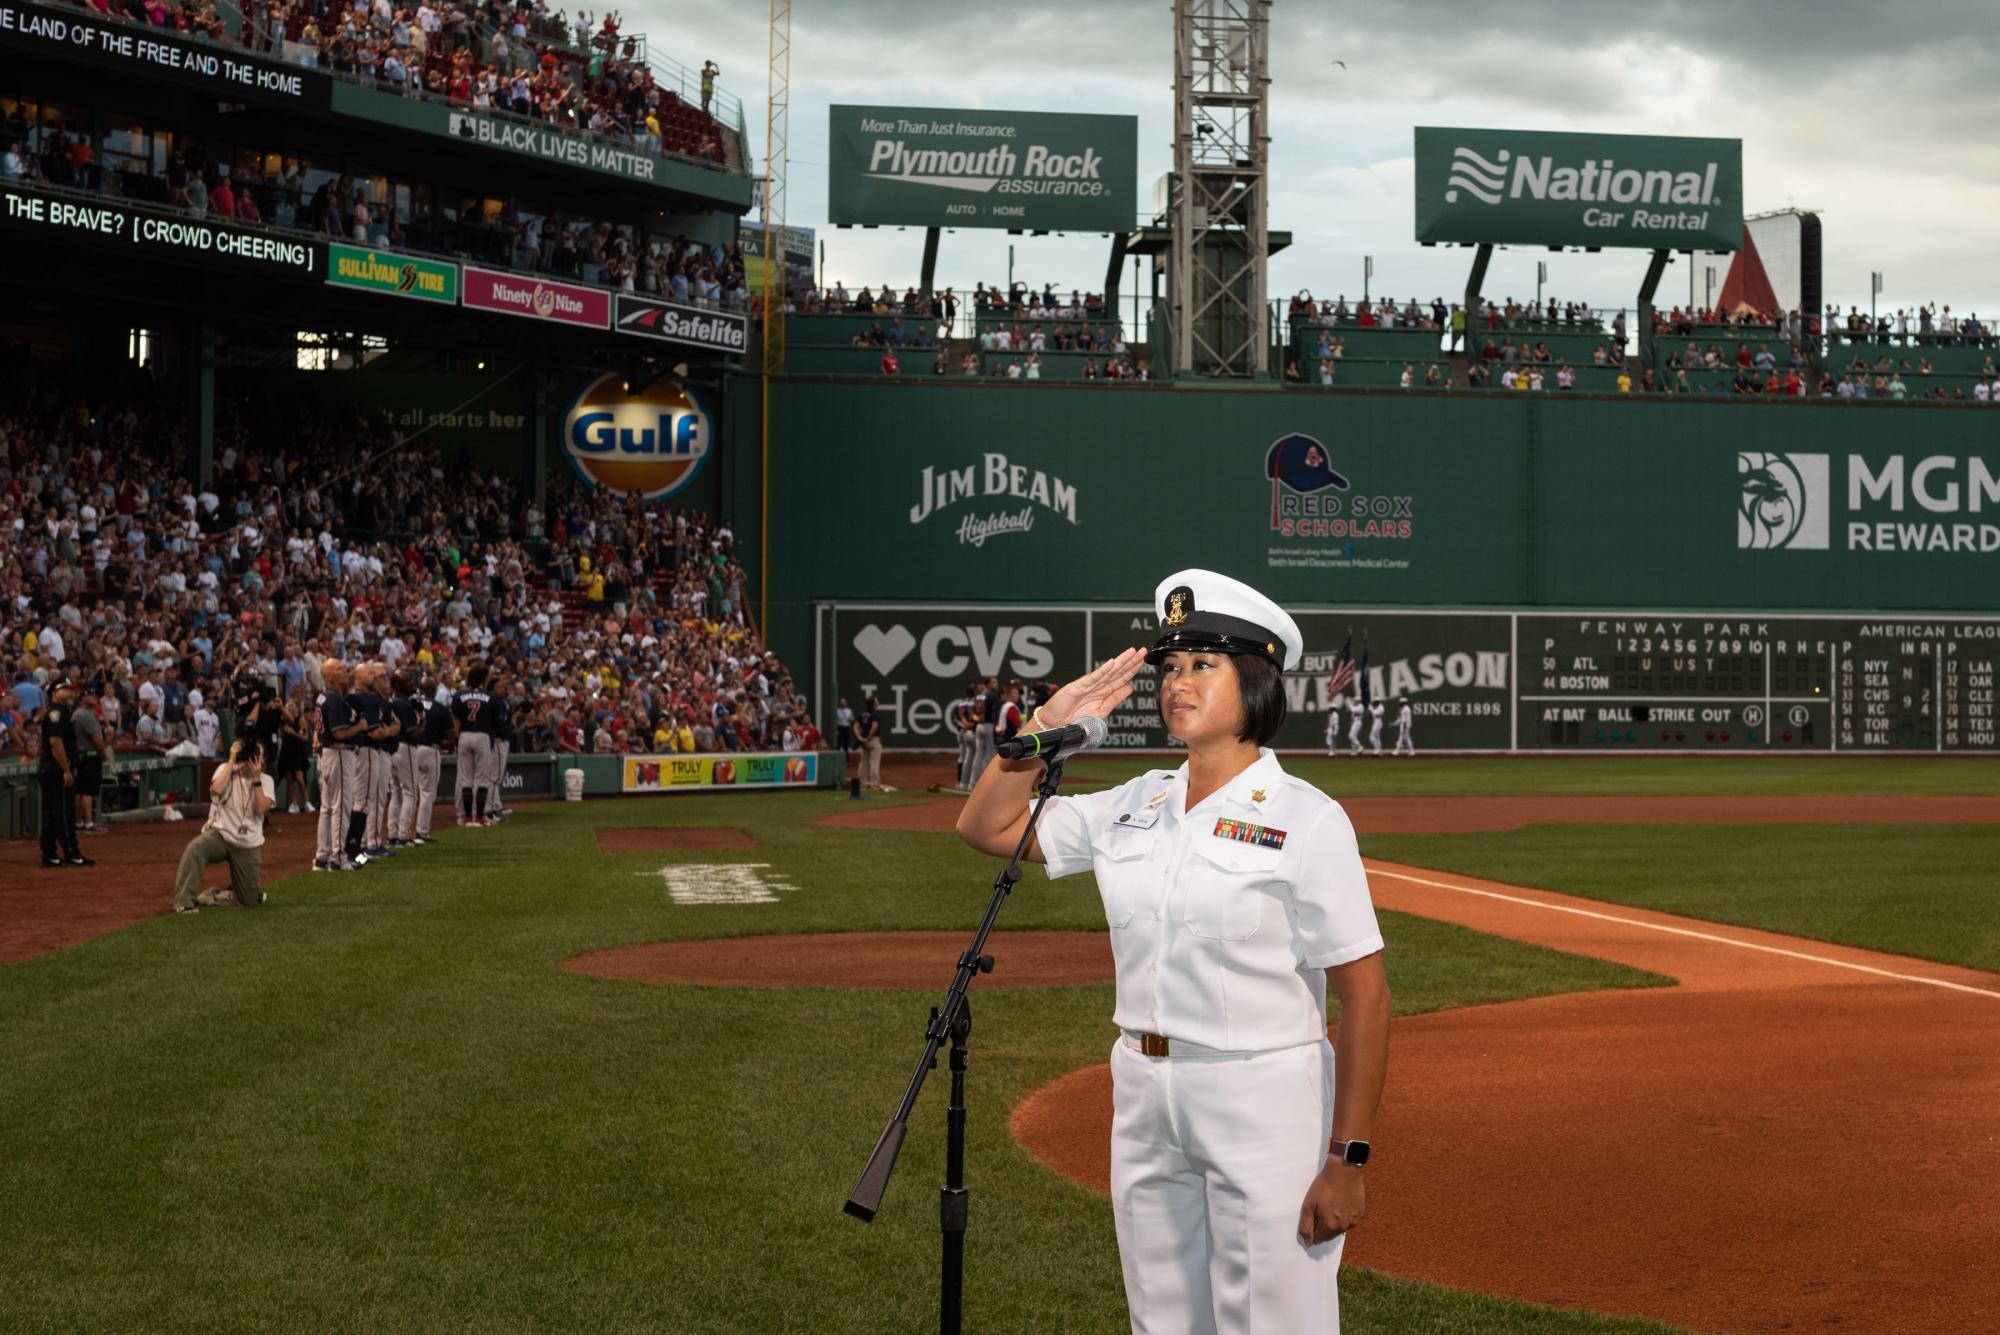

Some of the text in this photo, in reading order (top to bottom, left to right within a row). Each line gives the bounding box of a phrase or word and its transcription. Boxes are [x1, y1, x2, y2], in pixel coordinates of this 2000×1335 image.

[19, 12, 67, 40] LAND
[71, 25, 96, 46] OF
[100, 32, 133, 57] THE
[137, 41, 181, 68] FREE
[184, 51, 219, 76] AND
[223, 60, 253, 85] THE
[257, 67, 302, 96] HOME
[860, 118, 1017, 138] More Than Just Insurance.
[478, 119, 655, 180] BLACK LIVES MATTER
[869, 140, 1103, 179] Plymouth Rock
[998, 178, 1104, 197] assurance
[1509, 155, 1719, 206] National
[5, 194, 44, 222] THE
[50, 201, 125, 235] BRAVE?
[946, 205, 1026, 217] AUTO HOME
[1583, 208, 1709, 231] Car Rental
[338, 252, 444, 293] SULLIVAN TIRE
[492, 282, 533, 308] Ninety
[555, 294, 584, 314] Nine
[662, 310, 744, 347] Safelite
[401, 408, 423, 425] all
[429, 412, 483, 427] starts
[572, 412, 699, 455] Gulf
[910, 453, 1080, 525] JIM BEAM
[1281, 495, 1413, 517] RED SOX
[956, 506, 1034, 547] Highball
[1280, 518, 1412, 538] SCHOLARS
[1849, 522, 2000, 552] REWARD
[1859, 625, 1946, 637] AMERICAN
[920, 625, 1054, 678] CVS
[1545, 639, 1554, 651] P
[1629, 639, 1637, 652] 2
[1643, 639, 1651, 652] 3
[1660, 639, 1670, 652] 4
[1674, 639, 1683, 652] 5
[1687, 639, 1696, 652] 6
[1706, 640, 1713, 652] 7
[1719, 640, 1728, 653] 8
[1732, 640, 1741, 653] 9
[1750, 640, 1763, 653] 10
[1777, 641, 1786, 653] R
[1798, 641, 1807, 653] H
[1817, 641, 1825, 653] E
[1843, 642, 1957, 655] P IN R P
[1304, 655, 1335, 671] BUT
[1543, 658, 1556, 670] 50
[1573, 658, 1597, 670] ATL
[1864, 660, 1888, 672] NYY
[1969, 661, 1993, 673] LAA
[1543, 676, 1609, 689] 44 BOSTON
[1864, 674, 1889, 686] SEA
[1969, 675, 1993, 687] OAK
[1863, 689, 1890, 702] CWS
[1969, 690, 1993, 702] CLE
[467, 700, 481, 721] 7
[1413, 702, 1501, 715] SINCE 1898
[1543, 709, 1586, 722] AT BAT
[1598, 709, 1632, 722] BALL
[1648, 708, 1695, 722] STRIKE
[1702, 709, 1731, 722] OUT
[1867, 703, 1886, 716] KC
[1969, 704, 1993, 716] DET
[1865, 718, 1889, 730] TOR
[1969, 719, 1993, 731] TEX
[1864, 732, 1889, 745] BAL
[1968, 733, 1995, 745] HOU
[671, 760, 702, 774] TRULY
[747, 758, 776, 773] TRULY
